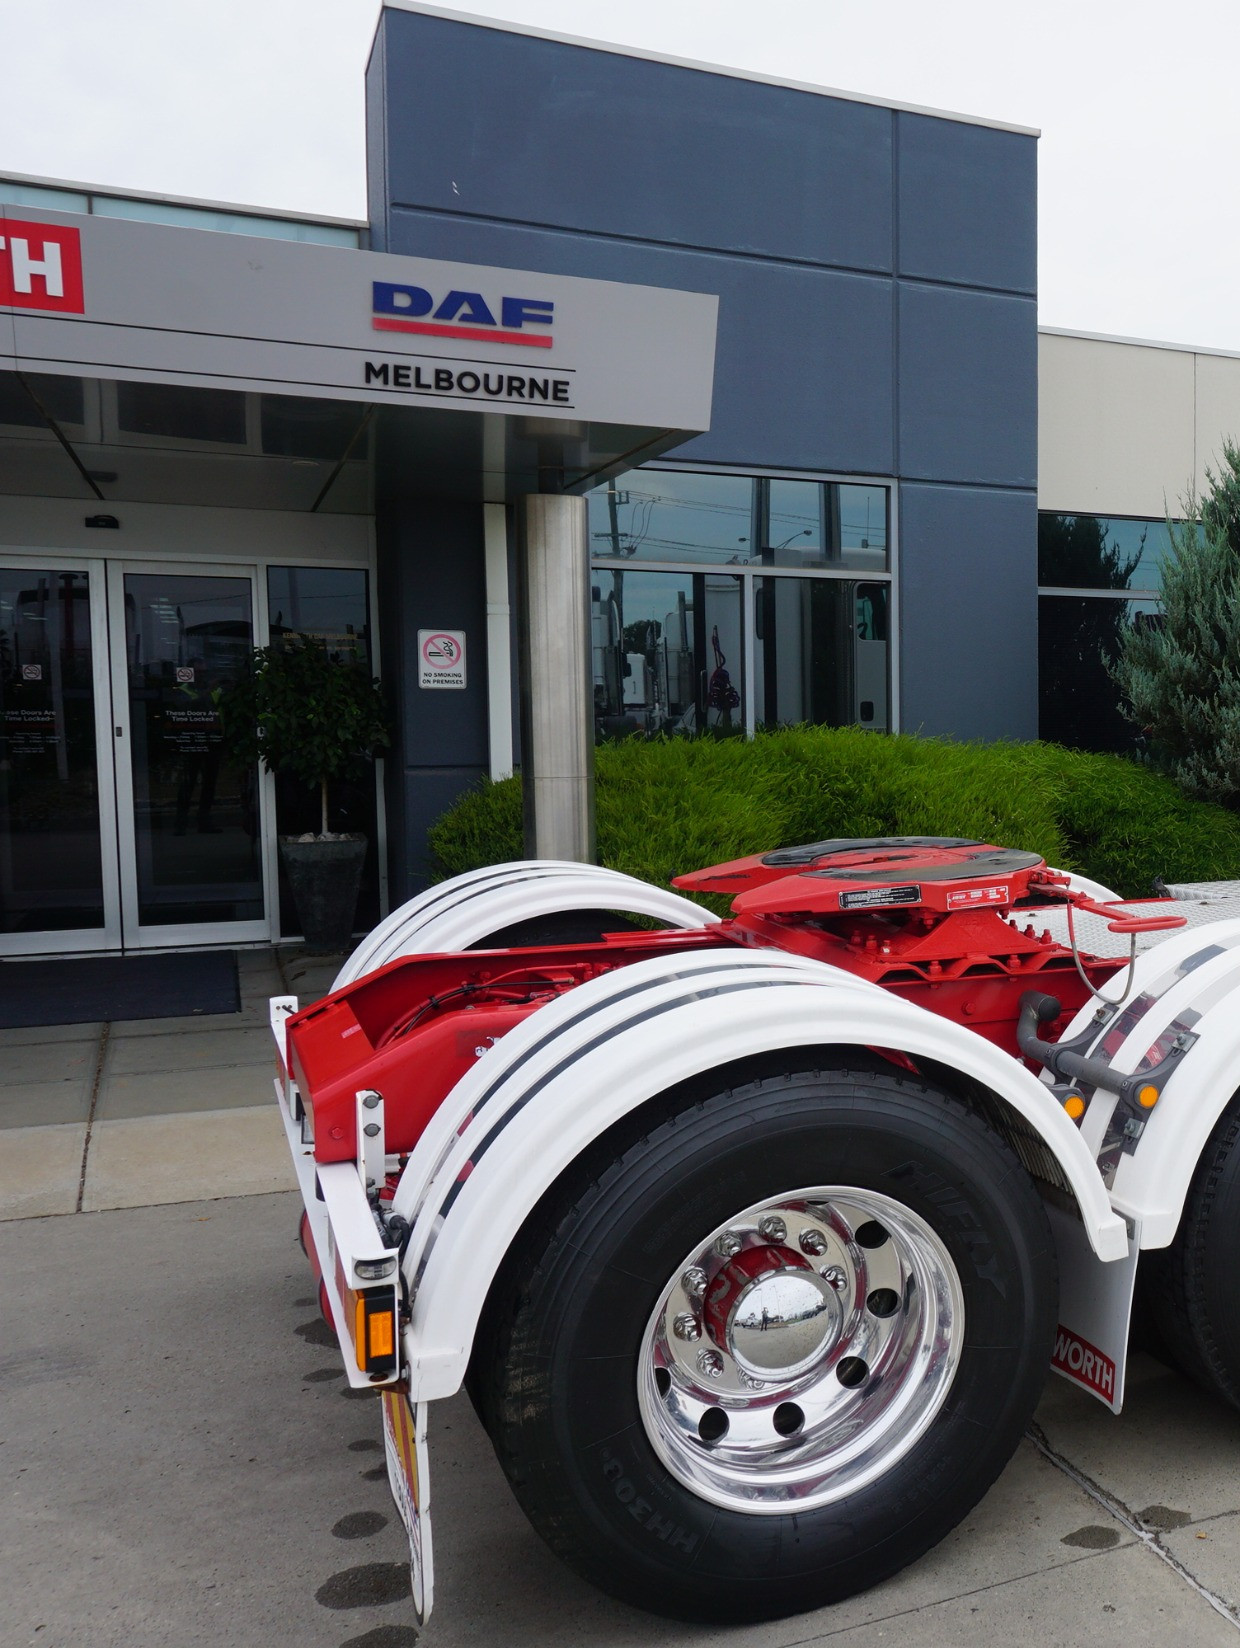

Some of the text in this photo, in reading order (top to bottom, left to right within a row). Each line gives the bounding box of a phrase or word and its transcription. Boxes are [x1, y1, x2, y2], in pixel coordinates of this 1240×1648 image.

[0, 235, 64, 298] H
[372, 281, 554, 328] DAF
[364, 361, 570, 402] MELBOURNE
[879, 1159, 1008, 1300] HIFLY
